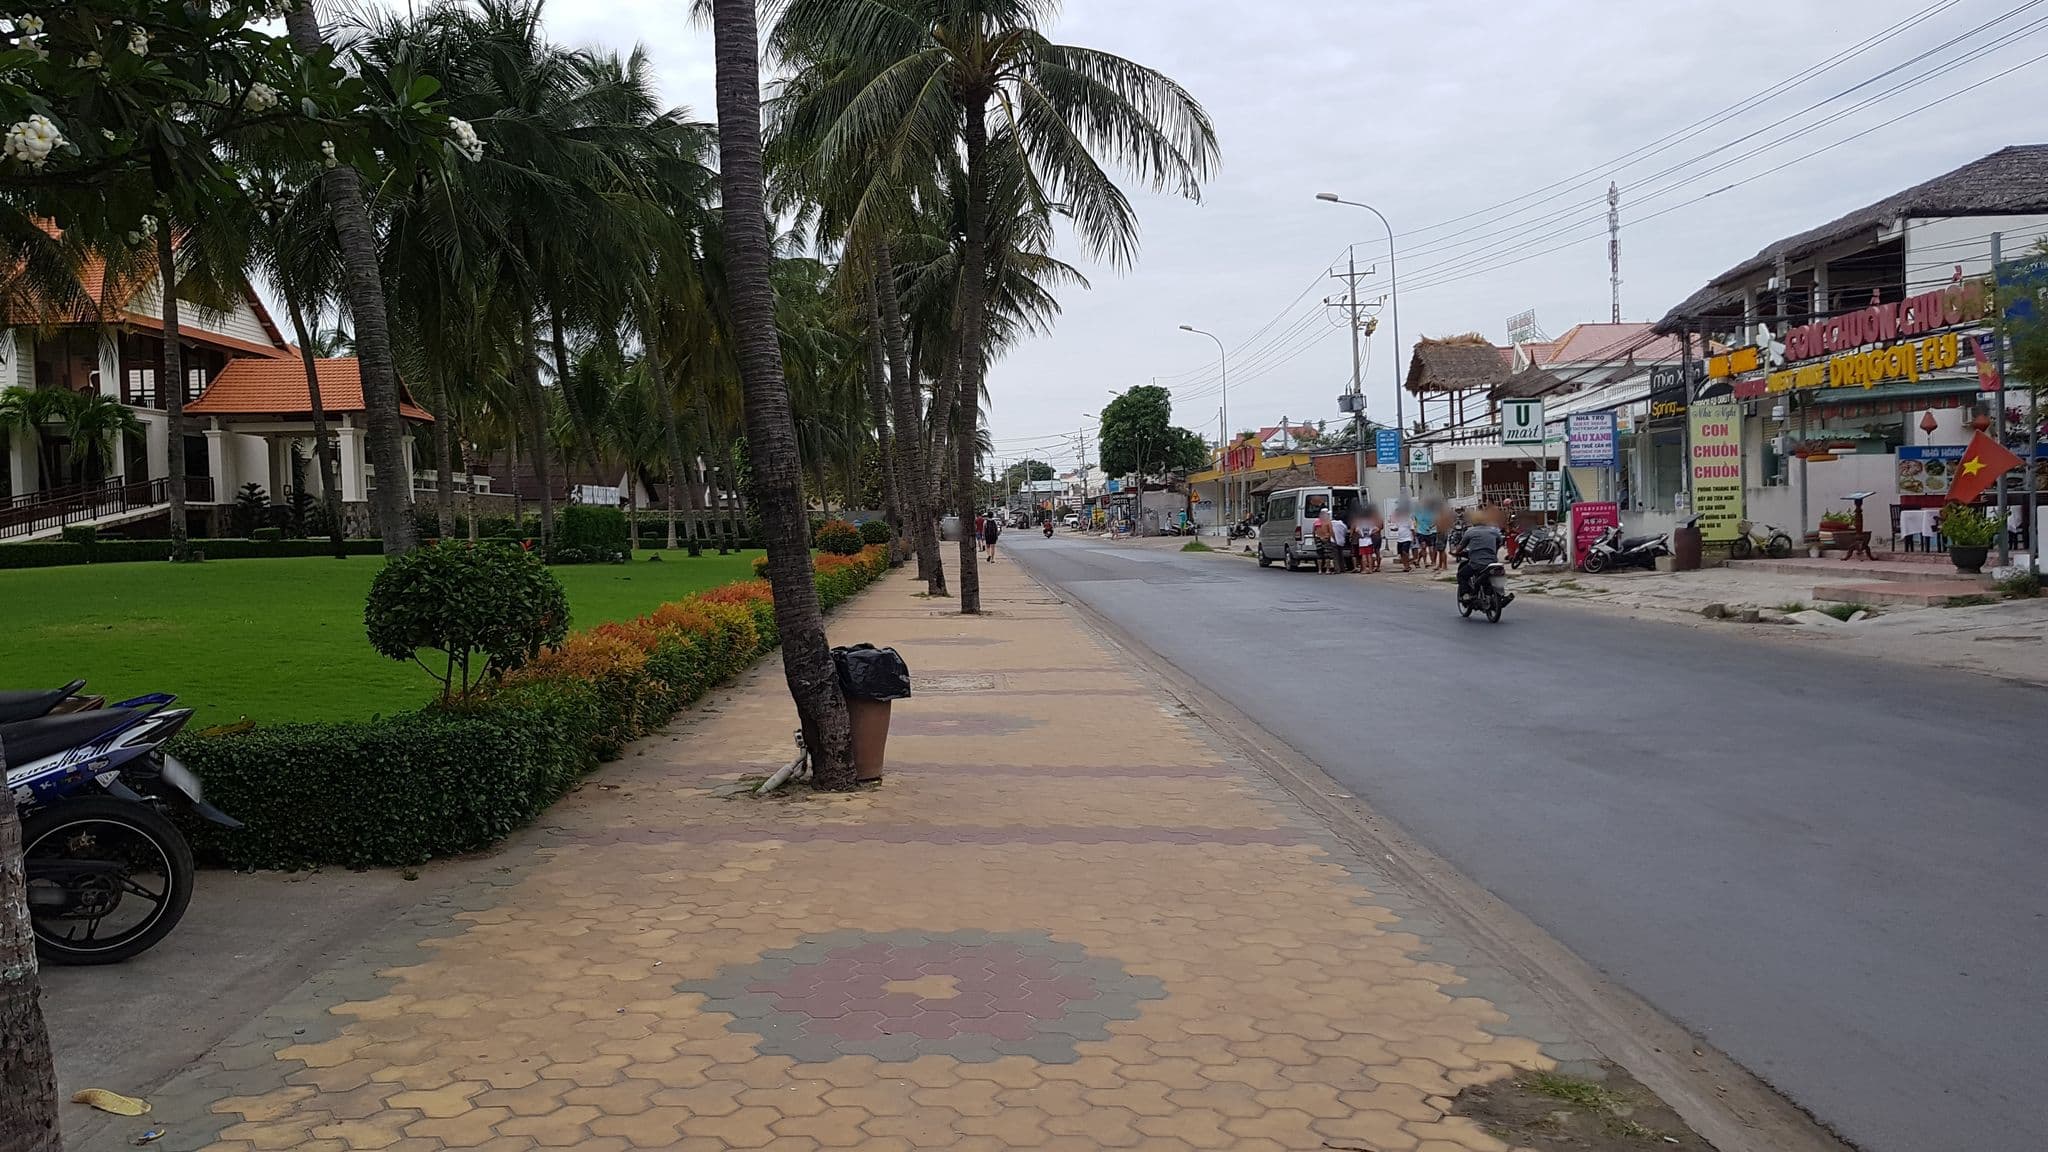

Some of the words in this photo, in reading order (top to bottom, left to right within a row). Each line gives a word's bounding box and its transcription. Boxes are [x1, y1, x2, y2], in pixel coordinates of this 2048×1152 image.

[1785, 322, 1825, 360] CON
[1830, 343, 1920, 390] DRAGON
[1921, 332, 1958, 373] FLY
[1516, 405, 1530, 427] U
[1652, 401, 1678, 418] Spring
[1507, 424, 1539, 439] mart
[1701, 424, 1729, 437] CON
